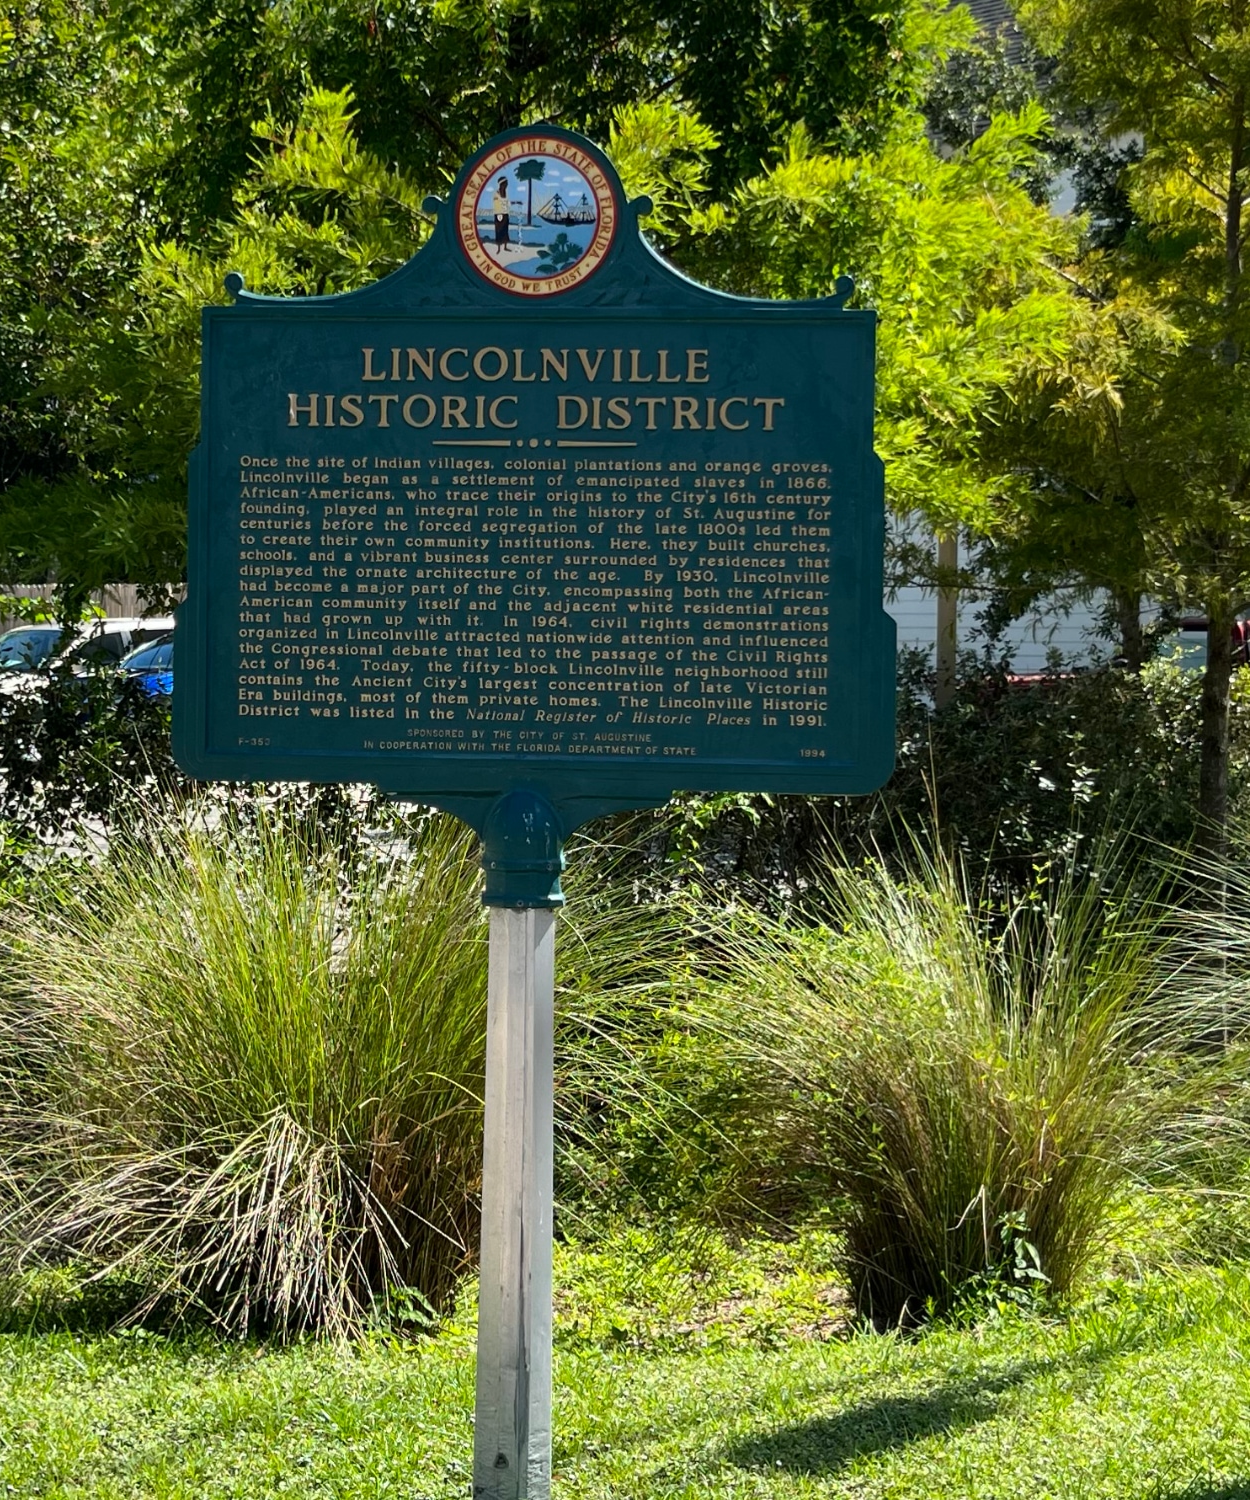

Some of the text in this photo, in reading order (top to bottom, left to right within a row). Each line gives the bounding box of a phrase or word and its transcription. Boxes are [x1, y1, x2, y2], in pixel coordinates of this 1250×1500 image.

[461, 140, 613, 259] GREAT SEAL OF THE STATE OF FLORIDA
[478, 260, 582, 292] IN GOD WE TRUST
[361, 346, 710, 383] LINCOLNVILLE
[287, 393, 785, 431] HISTORIC DISTRICT
[239, 454, 279, 468] Once
[285, 455, 311, 468] the
[316, 455, 346, 469] site
[351, 455, 369, 469] of
[374, 456, 422, 470] Indian
[503, 457, 567, 471] colonial
[574, 458, 663, 477] plantations
[668, 460, 698, 472] and
[704, 461, 762, 478] orange
[239, 470, 331, 484] Lincolnville
[342, 471, 389, 490] began
[401, 474, 419, 485] as
[430, 474, 440, 485] a
[451, 470, 536, 487] settlement
[546, 473, 564, 487] of
[575, 474, 681, 493] emancipated
[693, 475, 746, 491] slaves
[759, 476, 775, 489] in
[405, 487, 438, 501] who
[444, 488, 490, 501] trace
[496, 489, 537, 502] their
[546, 489, 603, 508] origins
[611, 490, 628, 503] to
[636, 490, 663, 503] the
[670, 489, 718, 509] City's
[723, 491, 757, 504] 16th
[765, 493, 833, 510] century
[239, 533, 256, 545] to
[261, 534, 313, 546] create
[319, 533, 359, 547] their
[364, 536, 396, 548] own
[404, 535, 490, 553] community
[498, 535, 595, 550] institutions.
[661, 538, 700, 556] they
[707, 538, 746, 552] built
[308, 549, 336, 562] and
[343, 551, 353, 562] a
[360, 549, 418, 563] vibrant
[423, 550, 490, 564] business
[500, 553, 554, 565] center
[563, 553, 658, 567] surrounded
[668, 553, 690, 572] by
[698, 554, 787, 568] residences
[797, 555, 831, 569] that
[239, 563, 313, 583] displayed
[321, 564, 348, 578] the
[355, 566, 408, 579] ornate
[415, 566, 518, 580] architecture
[525, 567, 543, 581] of
[552, 568, 580, 581] the
[587, 570, 621, 584] age.
[643, 568, 665, 585] By
[733, 570, 831, 584] Lincolnville
[239, 594, 830, 618] American community itself and the adjacent white residential areas
[238, 625, 829, 648] organized in Lincolnville attracted nationwide attention and influenced
[238, 656, 267, 670] Act
[273, 657, 291, 670] of
[299, 655, 341, 671] 1964.
[427, 660, 453, 673] the
[568, 661, 665, 677] Lincolnville
[674, 664, 789, 684] neighborhood
[795, 666, 829, 680] still
[237, 673, 828, 696] contains the Ancient City's largest concentration of late Victorian
[238, 687, 264, 701] Era
[359, 691, 396, 703] most
[405, 690, 422, 704] of
[431, 691, 469, 705] them
[478, 692, 539, 712] private
[548, 694, 602, 707] homes.
[617, 695, 650, 708] The
[658, 695, 753, 710] Lincolnville
[762, 697, 828, 711] Historic
[238, 703, 827, 727] District was listed in the National Register of Historic Places in 1991.
[407, 729, 464, 739] SPONSORED
[471, 730, 485, 739] BY
[493, 730, 512, 740] THE
[519, 731, 544, 740] CITY
[552, 732, 565, 740] OF
[594, 732, 652, 742] AUGUSTINE
[363, 740, 696, 756] IN COOPERATION WITH THE FLORIDA DEPARTMENT OF STATE
[800, 749, 826, 758] 1994
